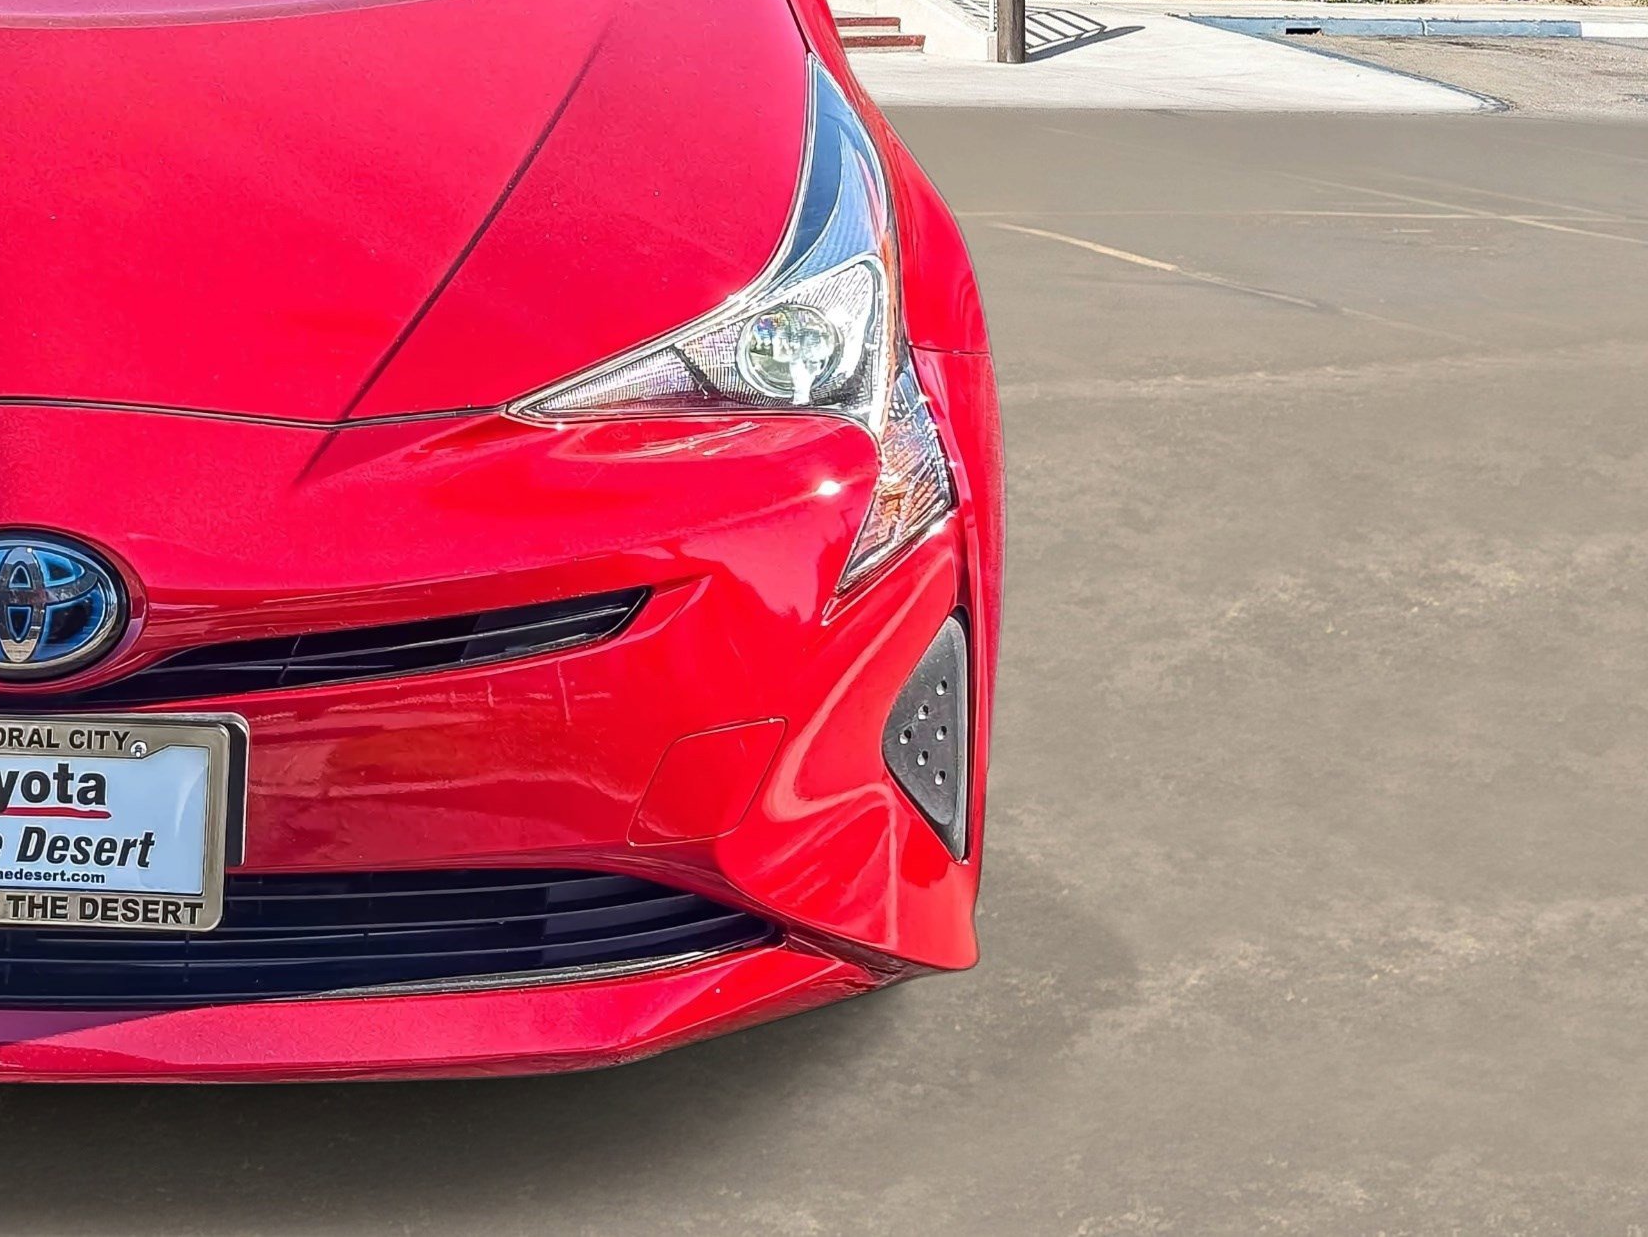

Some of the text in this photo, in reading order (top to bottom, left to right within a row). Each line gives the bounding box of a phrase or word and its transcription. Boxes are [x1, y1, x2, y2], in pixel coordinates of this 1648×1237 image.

[68, 729, 130, 752] CITY
[15, 826, 156, 869] Desert
[6, 893, 69, 921] THE
[78, 896, 205, 926] DESERT
